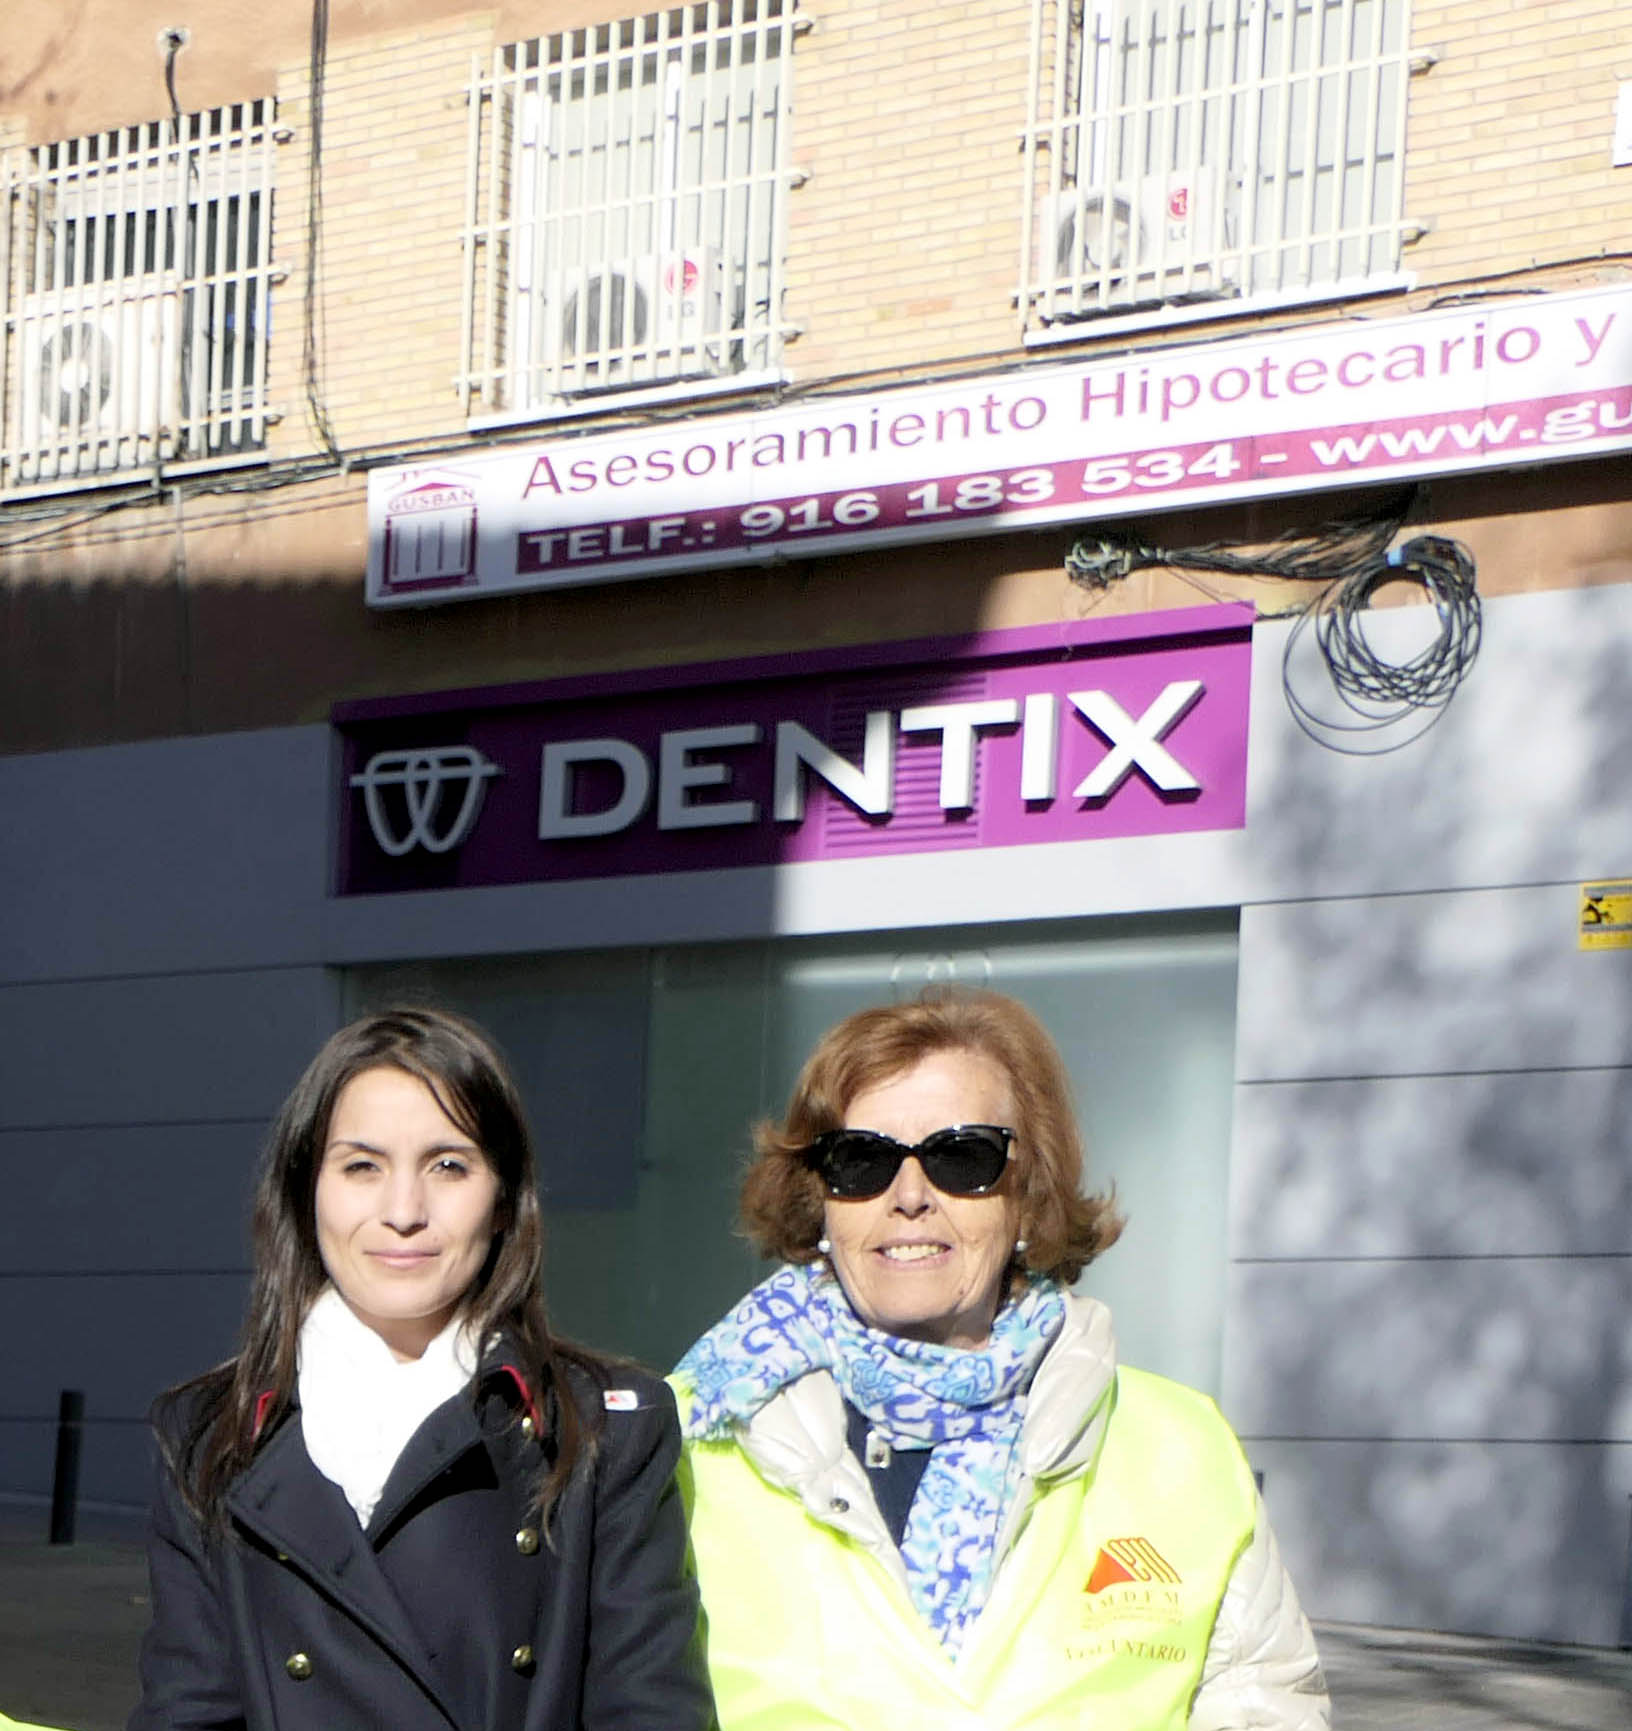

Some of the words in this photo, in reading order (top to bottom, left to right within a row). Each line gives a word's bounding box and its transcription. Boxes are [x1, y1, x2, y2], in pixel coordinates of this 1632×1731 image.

[522, 391, 1048, 500] Asesoramiento
[1079, 320, 1544, 424] Hipotecario
[1575, 312, 1618, 366] y
[388, 489, 475, 513] GUSBAN
[527, 517, 716, 564] TELF.:
[740, 491, 881, 539] 916
[905, 467, 1056, 518] 183
[1080, 443, 1241, 494] 534
[538, 679, 1203, 841] DENTIX
